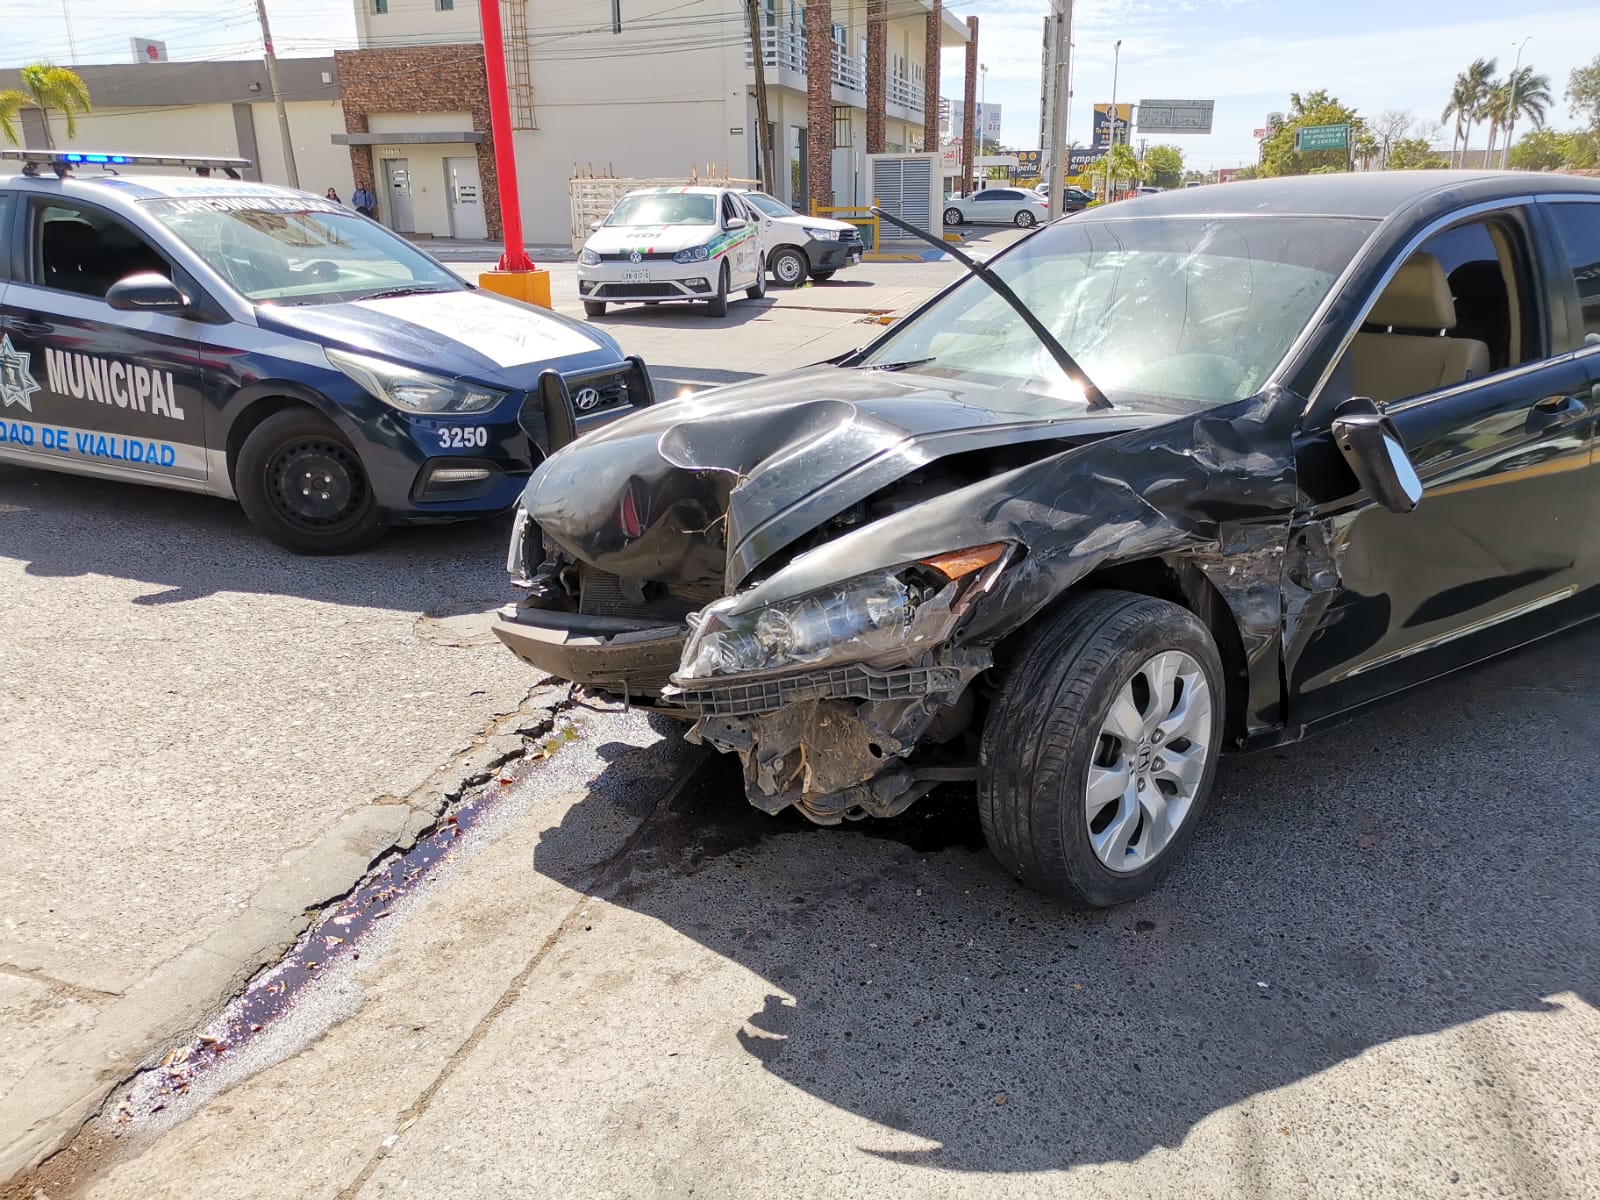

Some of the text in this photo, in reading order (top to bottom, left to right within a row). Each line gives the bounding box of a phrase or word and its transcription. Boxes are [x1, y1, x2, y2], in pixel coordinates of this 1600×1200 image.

[44, 347, 185, 421] MUNICIPAL
[42, 427, 70, 451] DE
[75, 432, 176, 468] VIALIDAD
[438, 426, 488, 448] 3250
